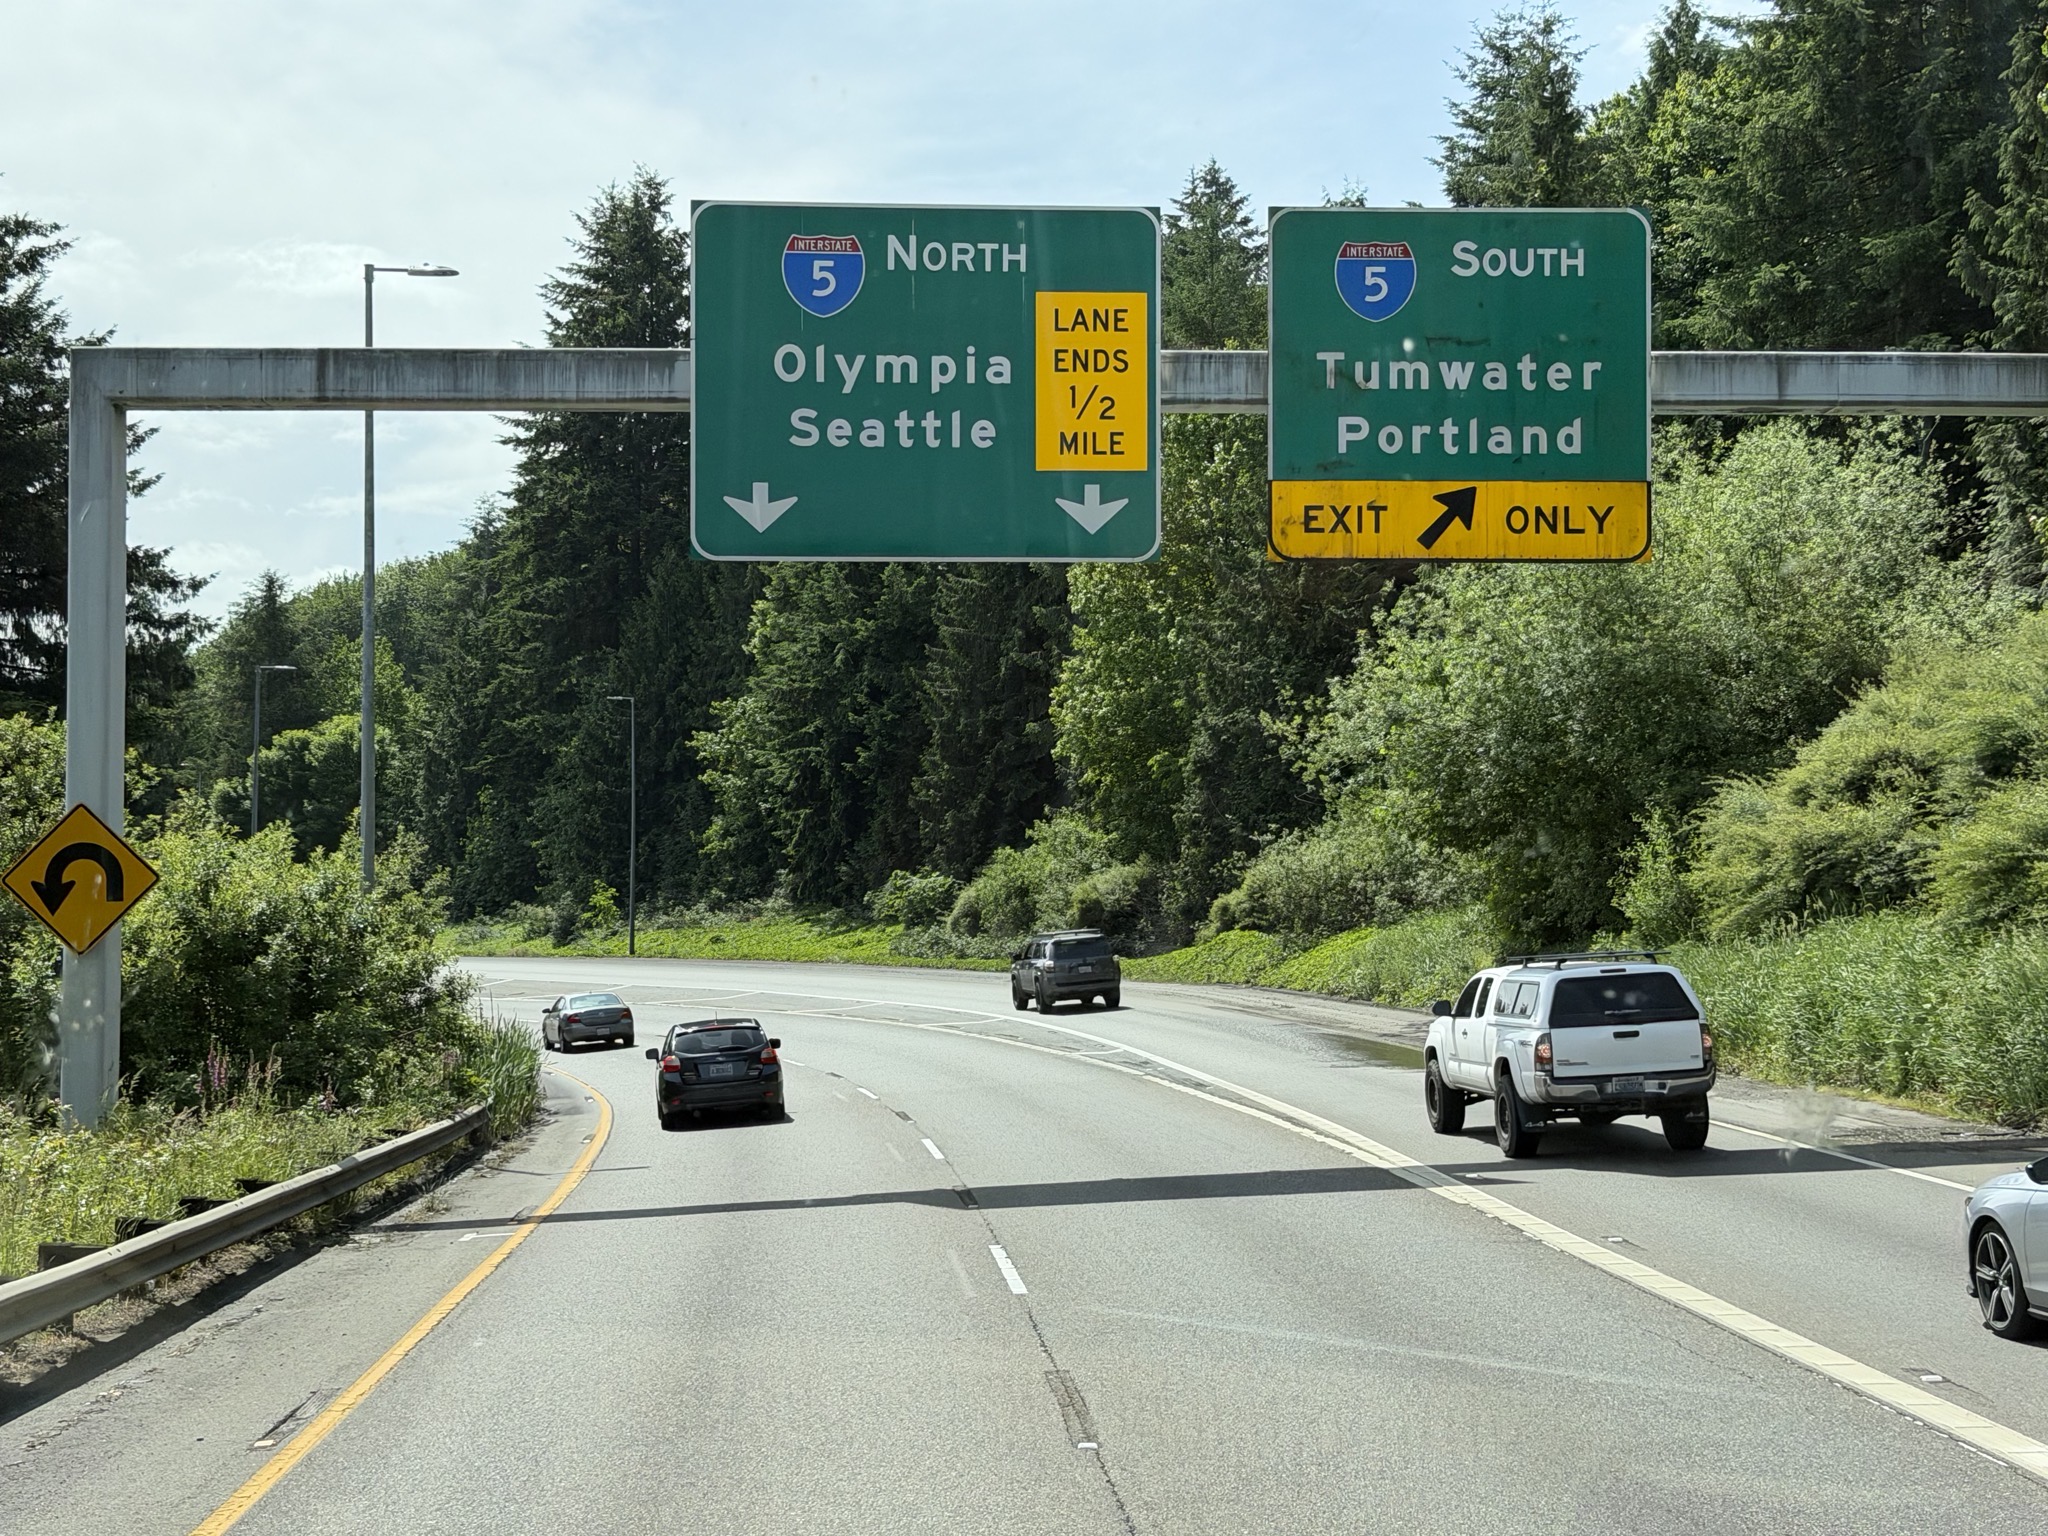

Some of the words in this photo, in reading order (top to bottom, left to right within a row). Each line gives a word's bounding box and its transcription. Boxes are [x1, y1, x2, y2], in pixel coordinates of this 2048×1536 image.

[795, 240, 852, 251] INTERSTATE
[887, 235, 1026, 272] NORTH
[1347, 247, 1404, 257] INTERSTATE
[1451, 241, 1584, 277] SOUTH
[812, 260, 836, 296] 5
[1365, 267, 1388, 302] 5
[1054, 309, 1129, 332] LANE
[774, 344, 1012, 393] Olympia
[1054, 349, 1129, 373] ENDS
[1316, 352, 1602, 390] Tumwater
[1069, 385, 1115, 420] 1/2
[789, 408, 997, 449] Seattle
[1060, 431, 1125, 455] MILE
[1337, 417, 1582, 454] Portland
[1304, 505, 1387, 533] EXIT
[1506, 506, 1614, 534] ONLY
